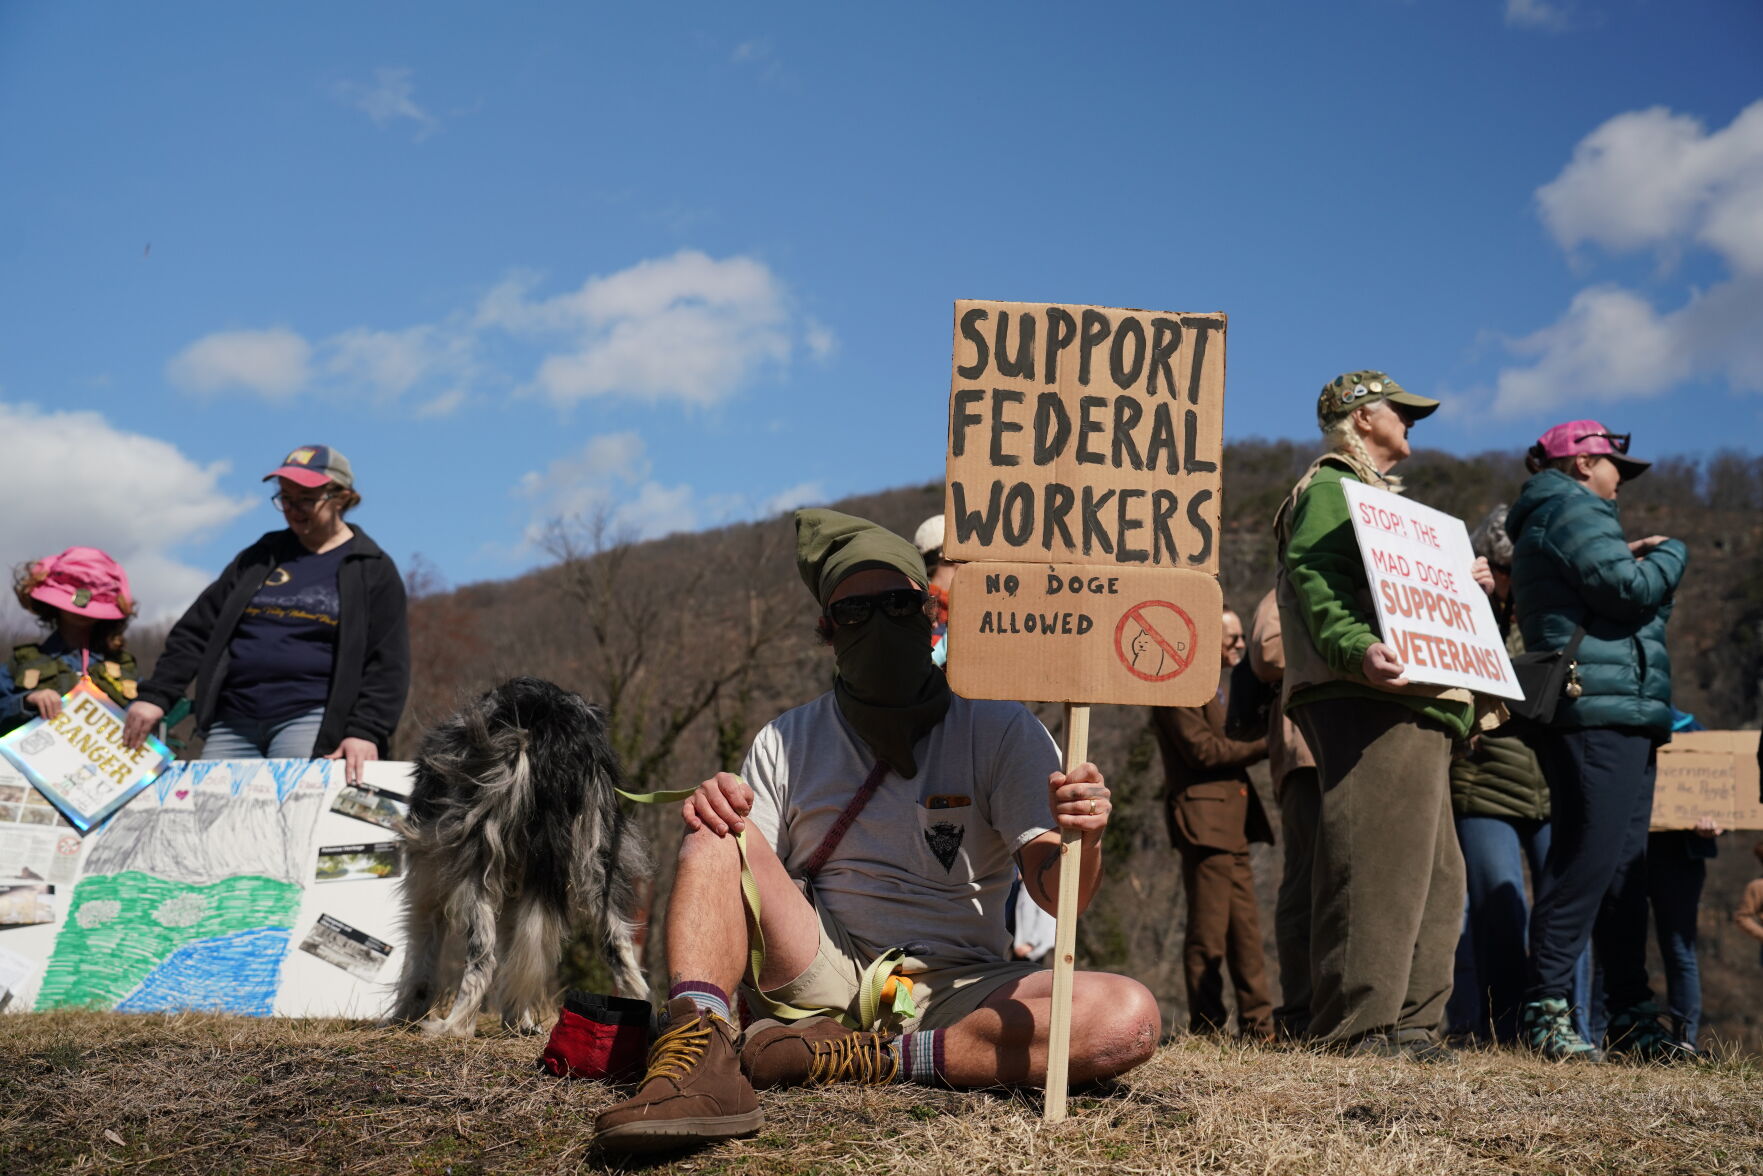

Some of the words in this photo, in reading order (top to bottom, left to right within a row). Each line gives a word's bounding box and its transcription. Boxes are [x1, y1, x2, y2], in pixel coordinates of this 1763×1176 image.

[956, 307, 1225, 405] SUPPORT
[952, 387, 1217, 476] FEDERAL
[951, 480, 1213, 565] WORKERS
[1359, 502, 1407, 537] STOP!
[1411, 519, 1440, 549] THE
[985, 573, 1020, 597] NO
[1045, 572, 1120, 595] DOGE
[1371, 548, 1410, 577] MAD
[1416, 560, 1458, 594] DOGE
[979, 610, 1094, 635] ALLOWED
[1380, 578, 1477, 636] SUPPORT
[1391, 627, 1508, 684] VETERANS!
[48, 711, 133, 785] RANGER
